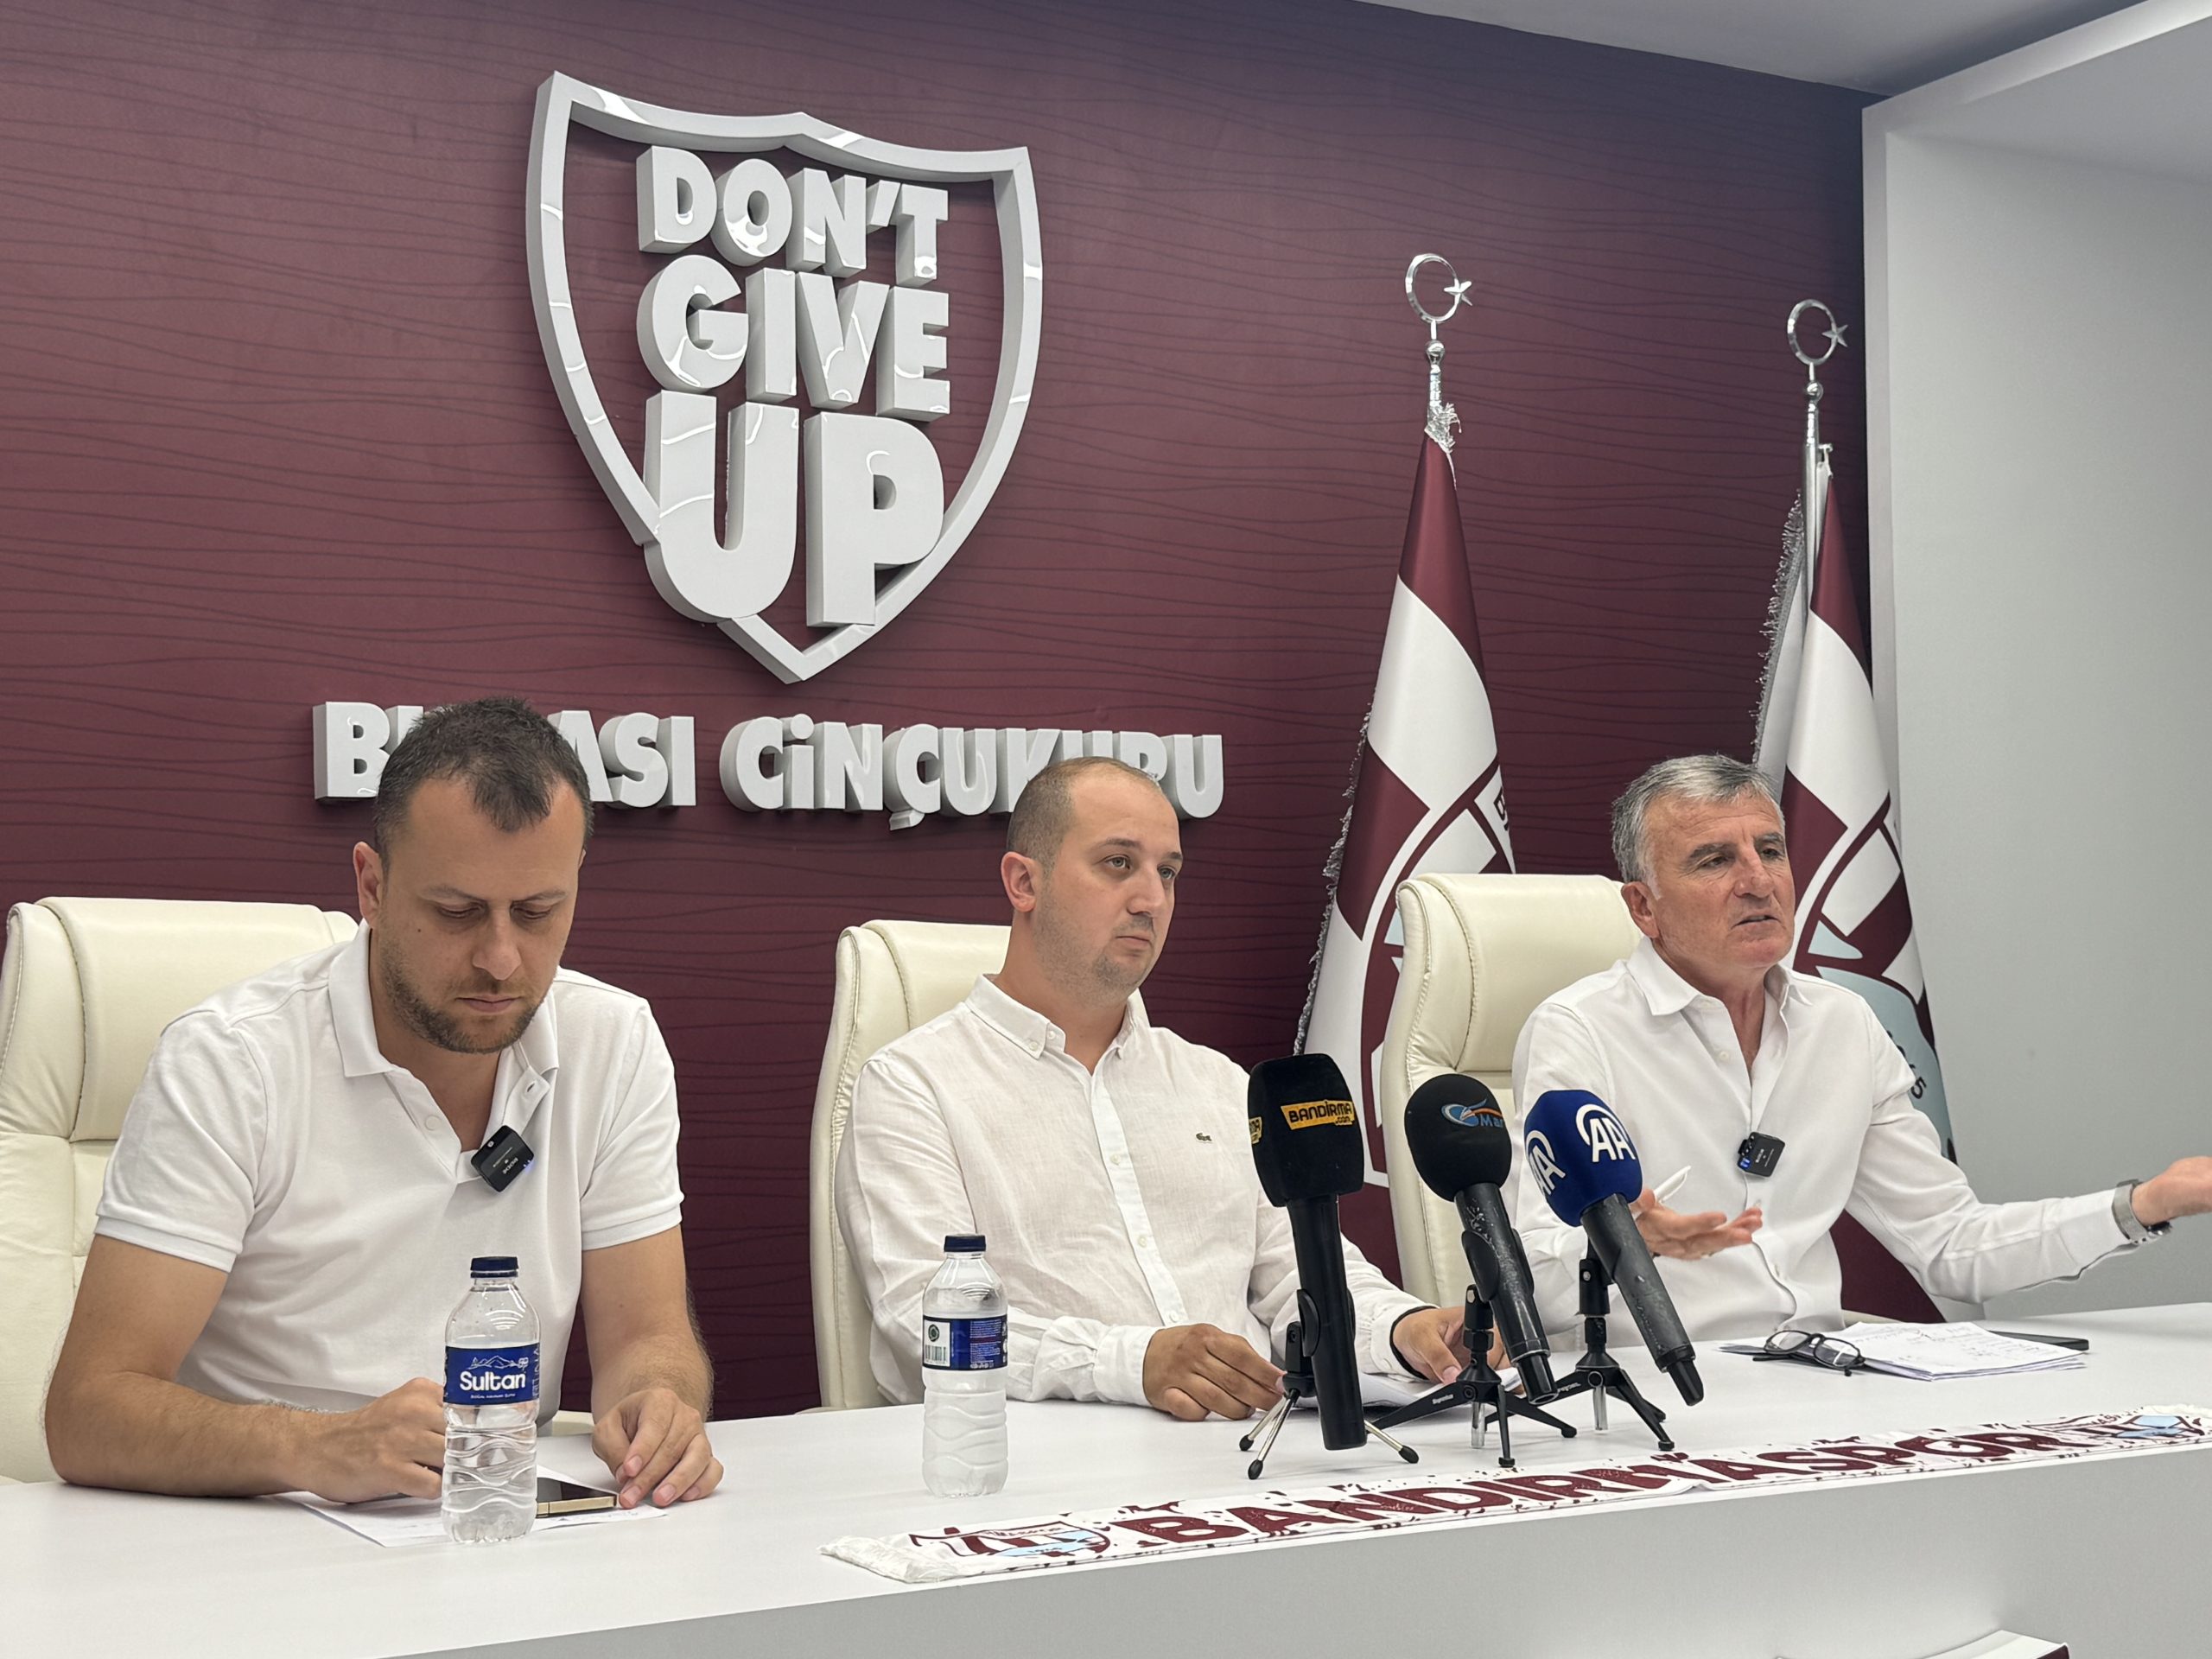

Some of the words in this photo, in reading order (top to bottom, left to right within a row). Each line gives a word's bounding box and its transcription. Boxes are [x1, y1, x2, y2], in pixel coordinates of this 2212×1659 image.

[641, 145, 949, 286] DON'T
[639, 254, 950, 421] GIVE
[646, 390, 945, 627] UP
[315, 701, 696, 809] BASI
[1588, 1116, 1637, 1163] AA
[460, 1370, 526, 1391] Sultan
